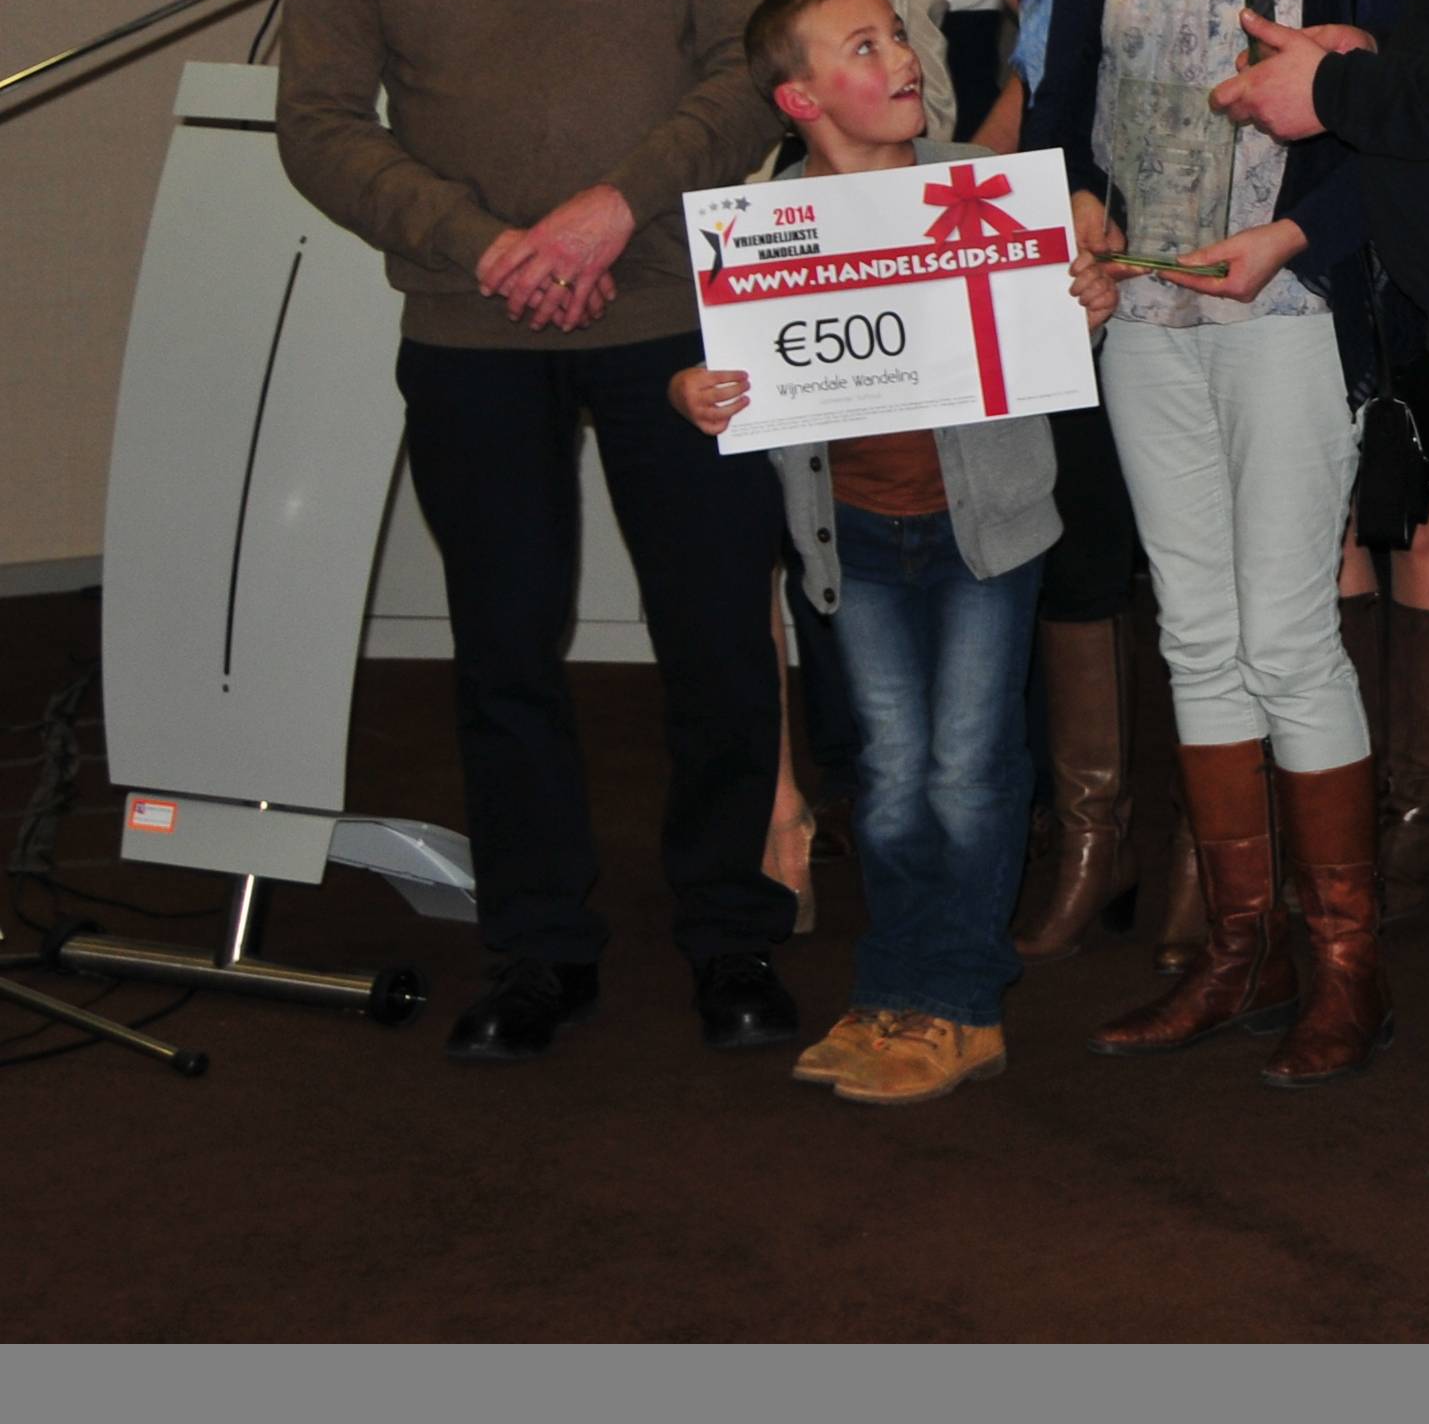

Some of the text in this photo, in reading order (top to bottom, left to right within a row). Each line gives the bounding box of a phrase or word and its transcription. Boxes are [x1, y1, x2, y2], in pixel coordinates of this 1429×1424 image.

[773, 204, 816, 227] 2014
[733, 227, 819, 249] VRIENDELIJKSTE
[758, 242, 821, 260] HANDELAAR
[728, 238, 1041, 295] WWW.HANDELSGIDS.BE
[773, 311, 906, 368] €500
[776, 373, 848, 398] Wijnendale
[852, 368, 919, 388] Wandeling
